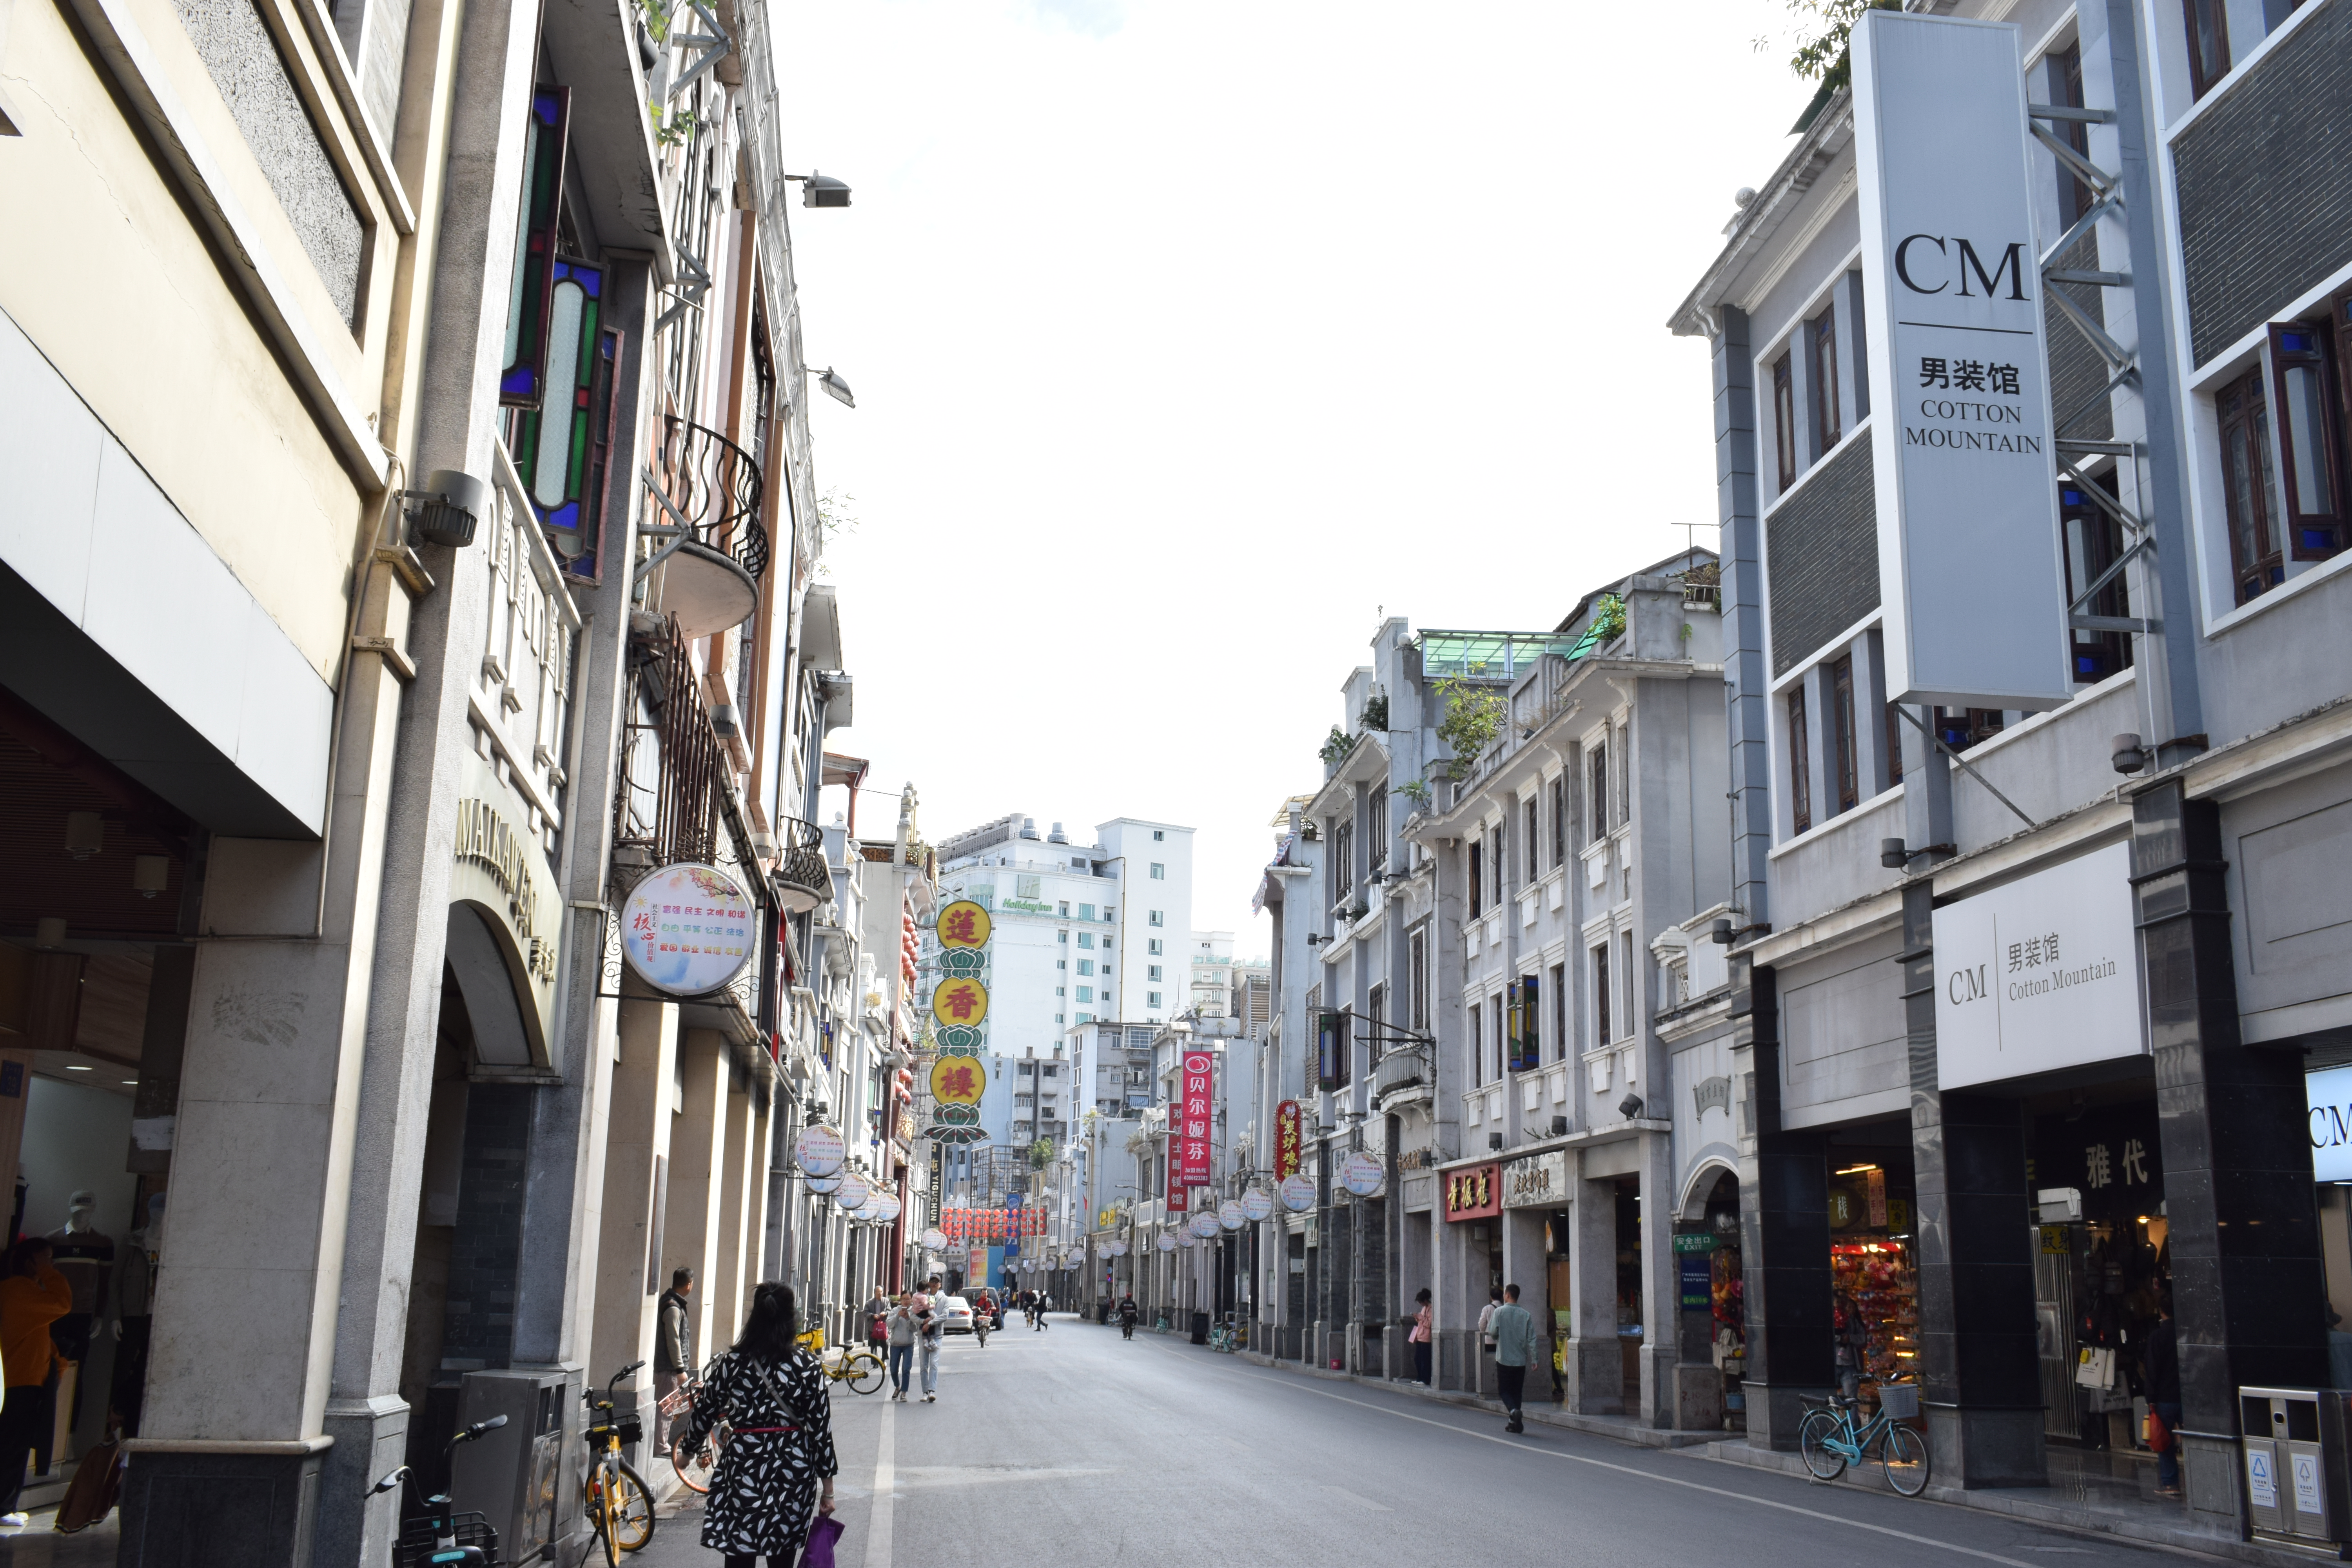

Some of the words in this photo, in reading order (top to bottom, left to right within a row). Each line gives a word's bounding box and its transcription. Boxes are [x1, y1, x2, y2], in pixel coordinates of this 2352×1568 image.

[1895, 234, 2031, 301] CM
[1920, 357, 2020, 395] 男装馆
[1921, 400, 2021, 423] COTTON
[1906, 427, 2041, 454] MOUNTAIN
[663, 905, 681, 914] 富强
[685, 906, 702, 916] 民主
[706, 908, 724, 917] 文明
[728, 910, 746, 919] 和谐
[1003, 898, 1038, 912] Holiday
[1038, 902, 1053, 911] Inn
[633, 913, 655, 940] 核心
[661, 924, 679, 932] 自由
[683, 925, 701, 933] 平等
[705, 927, 722, 935] 公正
[726, 928, 744, 937] 法治
[660, 943, 677, 952] 爱国
[682, 944, 699, 953] 敬业
[704, 946, 721, 955] 诚信
[725, 948, 742, 956] 友善
[2008, 932, 2059, 973] 男装馆
[1949, 964, 1987, 1005] CM
[2009, 979, 2049, 1001] Cotton
[2053, 957, 2116, 990] Mountain
[941, 909, 980, 1097] 蓮香樓
[1188, 1077, 1205, 1160] 贝尔妮芬
[2086, 1139, 2148, 1188] 雅代
[1677, 1236, 1710, 1245] 安全出口
